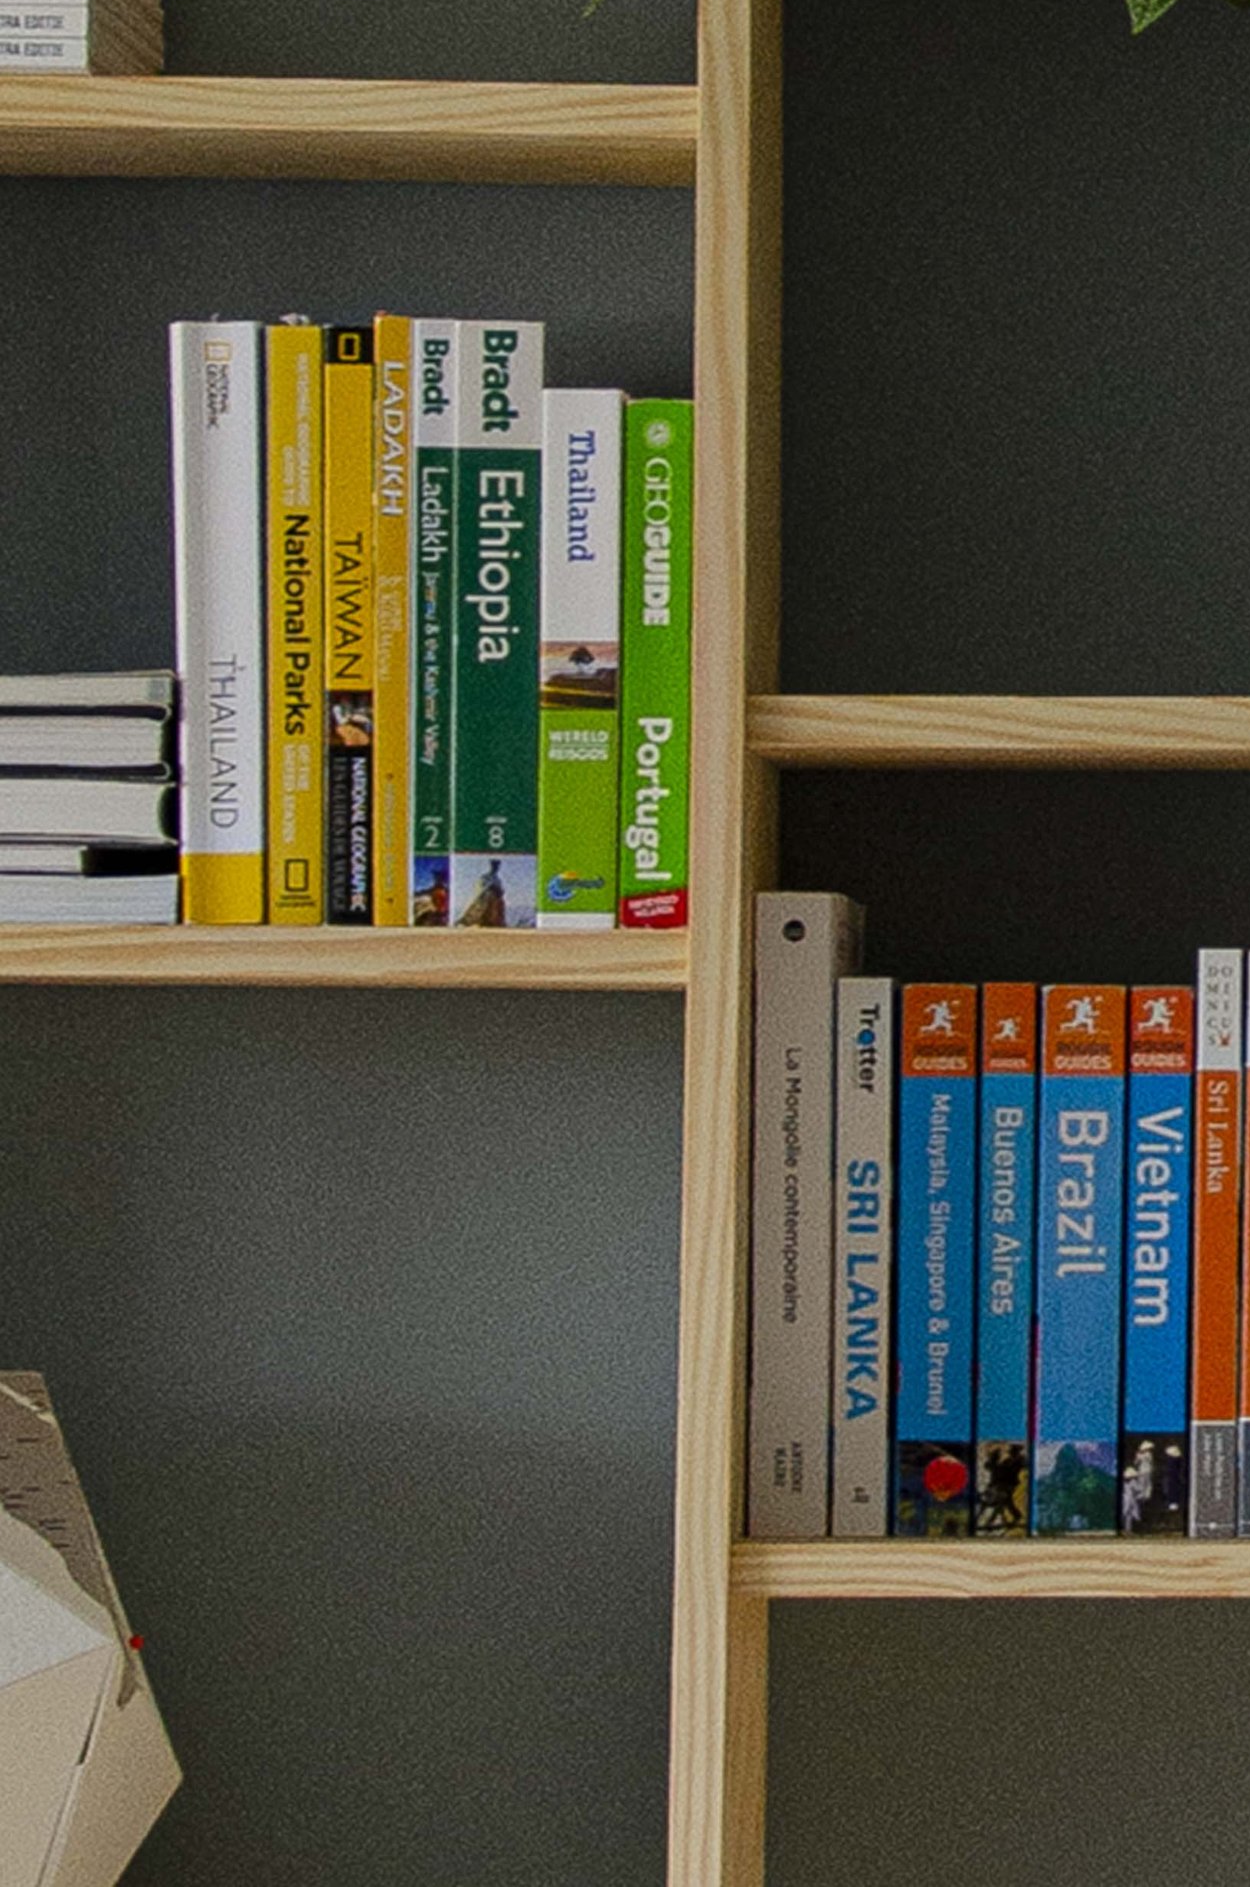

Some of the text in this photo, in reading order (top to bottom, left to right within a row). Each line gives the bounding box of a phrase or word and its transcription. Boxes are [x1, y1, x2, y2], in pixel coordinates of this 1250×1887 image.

[381, 361, 405, 516] LADAKH
[422, 338, 450, 416] Bradt
[482, 329, 519, 433] Bradt
[421, 466, 450, 562] Ladakh
[465, 470, 525, 663] Ethiopia
[567, 429, 597, 563] Thailand
[642, 456, 674, 627] GEOGUIDE
[283, 514, 312, 737] National Parks
[334, 532, 370, 680] TAÏWAN
[424, 623, 440, 635] &
[209, 653, 238, 830] THAILAND
[351, 756, 367, 823] NATIONAL
[625, 717, 674, 881] Portugal
[424, 825, 441, 848] 2
[487, 825, 504, 848] 8
[856, 1002, 881, 1094] Trotter
[1054, 1054, 1112, 1070] GUIDES
[781, 1047, 803, 1324] La Mongolie contemporaine
[990, 1106, 1024, 1315] Buenos Aires
[1056, 1109, 1110, 1279] Brazil
[1206, 1079, 1230, 1194] Sri Lanka
[845, 1159, 882, 1421] SRI LANKA
[925, 1093, 952, 1415] Malaysia, Singapore & Brunei
[1132, 1106, 1185, 1327] Vietnam
